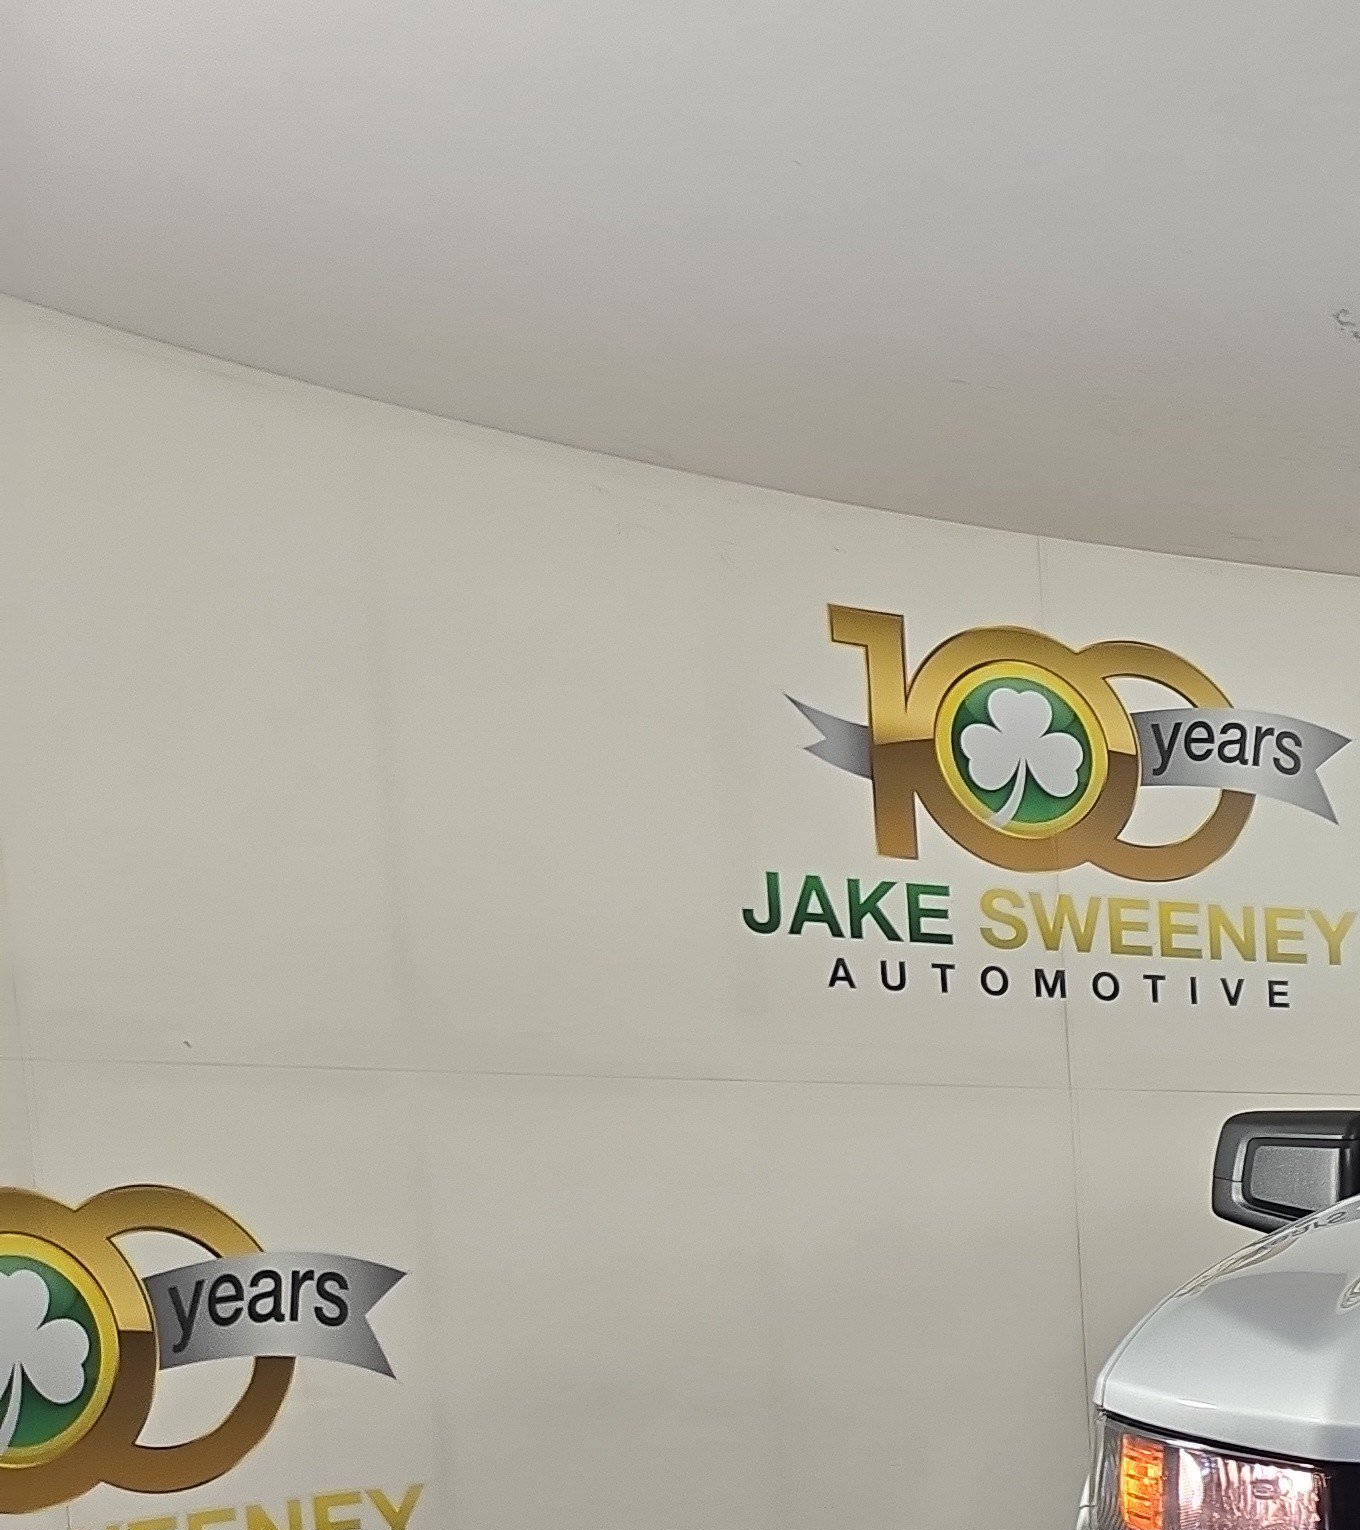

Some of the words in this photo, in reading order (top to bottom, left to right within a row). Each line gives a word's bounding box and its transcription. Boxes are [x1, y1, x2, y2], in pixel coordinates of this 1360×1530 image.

[828, 603, 1256, 882] 100
[1151, 715, 1304, 776] years
[742, 871, 954, 945] JAKE
[979, 888, 1358, 966] SWEENEY
[828, 958, 1291, 1009] AUTOMOTIVE
[167, 1267, 351, 1353] years
